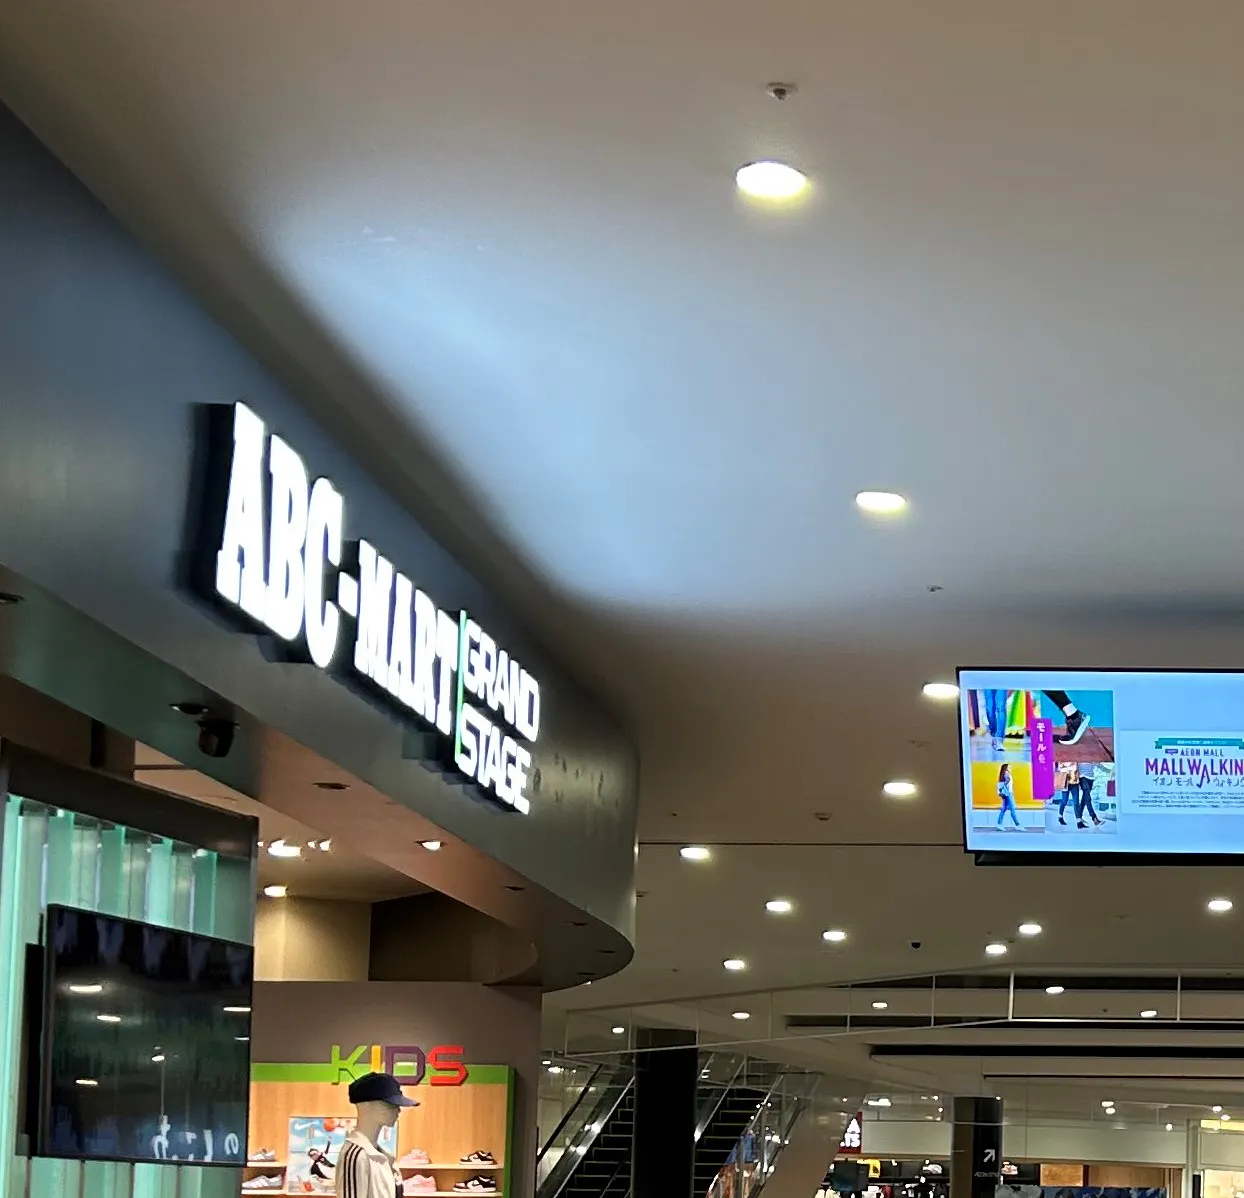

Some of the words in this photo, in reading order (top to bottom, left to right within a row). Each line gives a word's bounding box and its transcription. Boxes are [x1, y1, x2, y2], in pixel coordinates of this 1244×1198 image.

[216, 401, 459, 736] ABC-MART
[463, 618, 540, 743] GRAND
[457, 702, 531, 815] STAGE
[1180, 748, 1201, 757] AEON
[1203, 748, 1225, 758] MALL
[331, 1044, 469, 1087] KIDS
